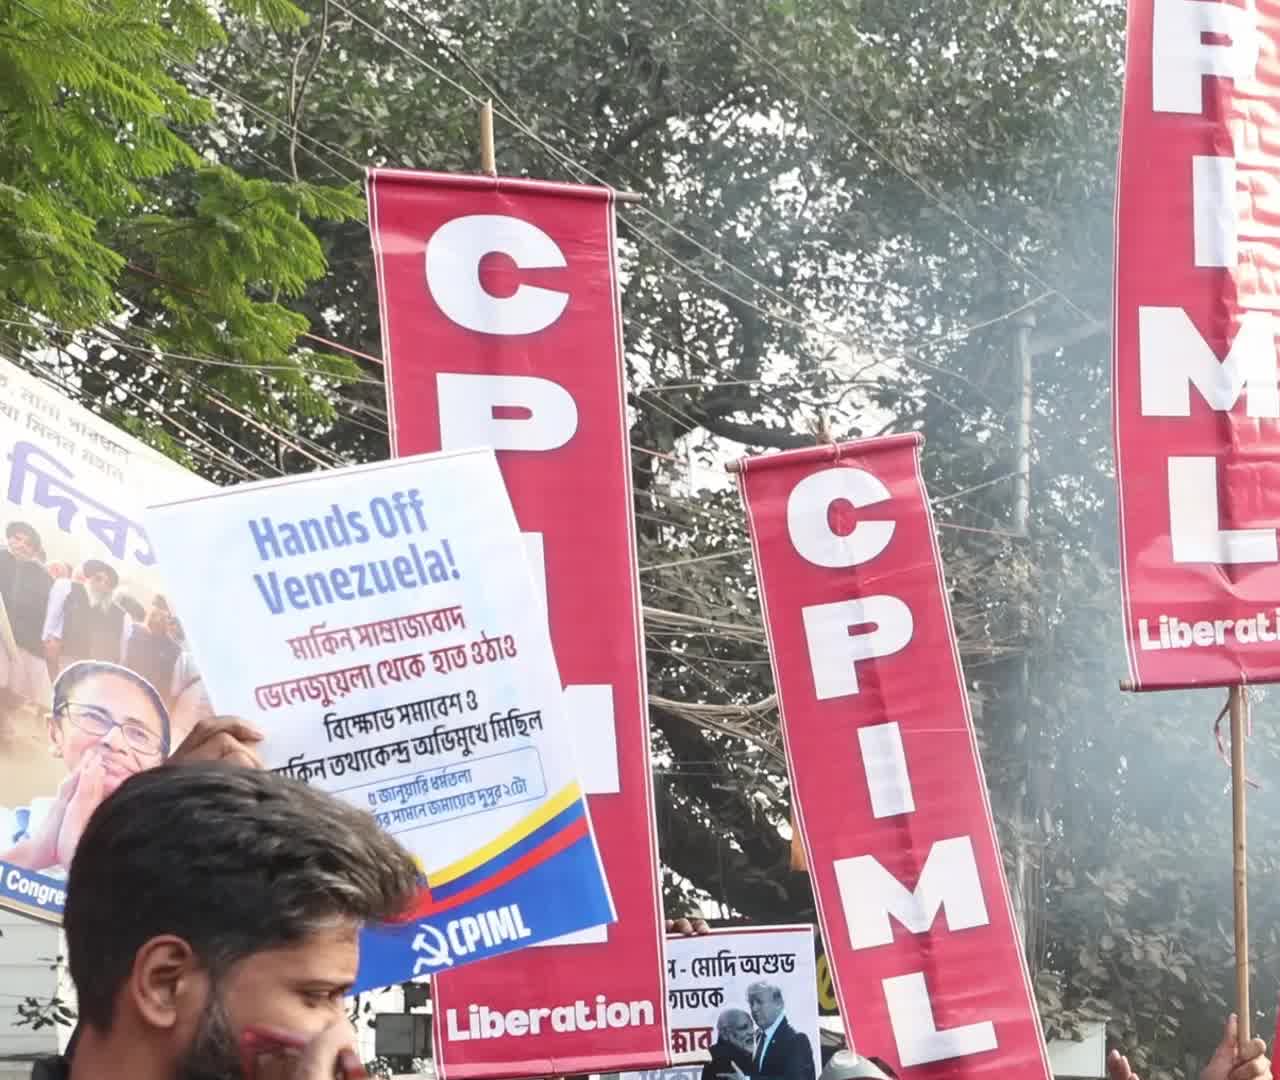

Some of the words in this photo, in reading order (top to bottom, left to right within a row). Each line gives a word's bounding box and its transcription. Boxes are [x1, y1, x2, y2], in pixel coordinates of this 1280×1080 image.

[249, 504, 370, 561] Hands
[369, 489, 428, 539] Off
[253, 539, 460, 614] Venezuela!
[377, 654, 425, 685] থেকে
[431, 645, 468, 674] হাত
[324, 712, 395, 742] বিক্ষোভ
[397, 691, 463, 726] সমাবেশ
[411, 722, 489, 757] অভিমুখে
[490, 708, 544, 740] মিছিল
[786, 467, 998, 1068] CPIML
[447, 903, 532, 958] CPIML
[691, 950, 736, 978] মোদি
[739, 953, 796, 975] অশুভ
[446, 992, 654, 1042] Liberation
